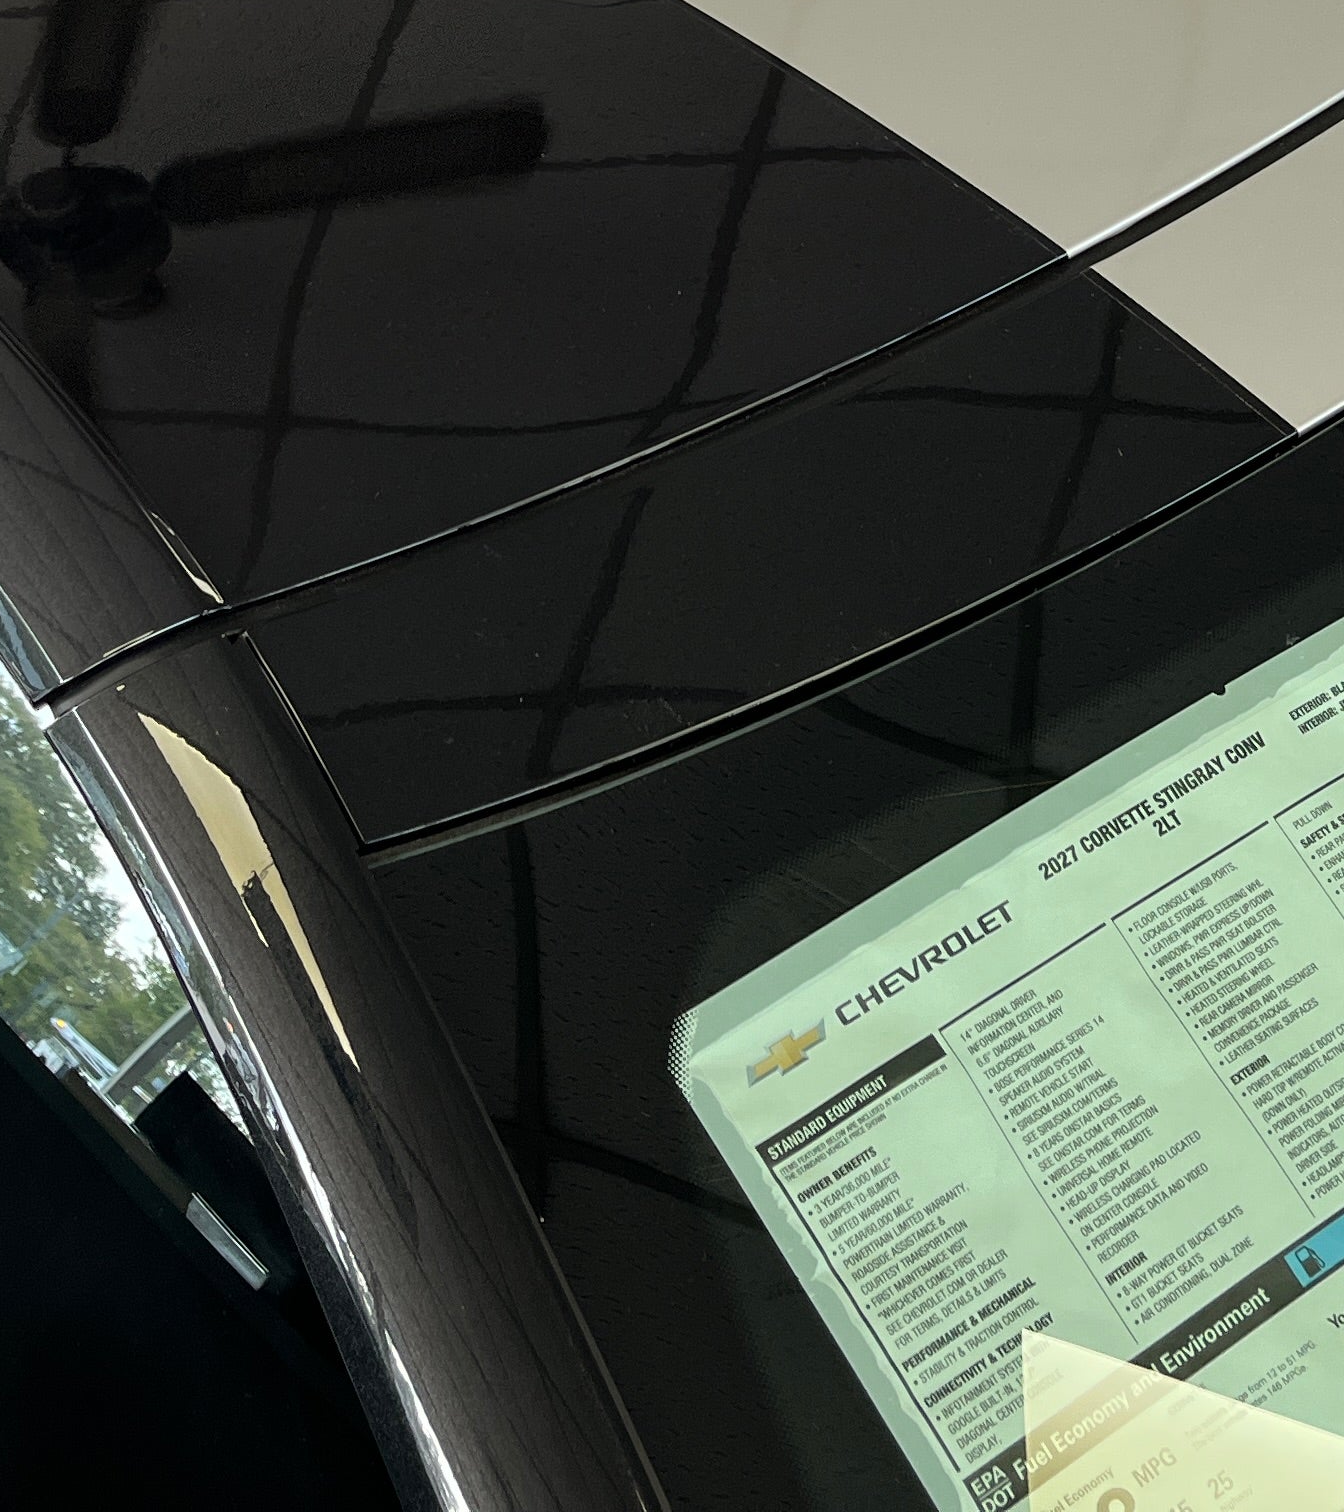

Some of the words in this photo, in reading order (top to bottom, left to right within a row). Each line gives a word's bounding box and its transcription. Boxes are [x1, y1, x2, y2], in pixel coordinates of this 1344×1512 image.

[1288, 693, 1332, 721] EXTERIOR:
[1297, 707, 1339, 735] INTERIOR:
[1038, 844, 1078, 880] 2027
[1080, 799, 1155, 853] CORVETTE
[1152, 755, 1225, 809] STINGRAY
[1224, 731, 1266, 764] CONV
[1152, 809, 1181, 837] 2LT
[1300, 824, 1331, 849] SAFETY
[1330, 820, 1340, 830] &
[835, 900, 1012, 1026] CHEVROLET
[1224, 1038, 1257, 1064] LEATHER
[1254, 1020, 1284, 1044] SEATING
[1281, 997, 1319, 1026] SURFACES
[1008, 1092, 1041, 1118] REMOTE
[1038, 1073, 1071, 1098] VEHICLE
[1068, 1057, 1094, 1079] START
[1230, 1054, 1271, 1086] EXTERIOR
[767, 1116, 827, 1160] STANDARD
[825, 1075, 887, 1123] EQUIPMENT
[797, 1175, 834, 1203] OWNER
[832, 1146, 877, 1181] BENEFITS
[819, 1171, 900, 1229] BUMPER-TO-BUMPER
[827, 1215, 860, 1242] LIMITED
[858, 1188, 901, 1221] WARRANTY
[860, 1263, 901, 1296] COURTESY
[899, 1219, 968, 1269] TRANSPORTATION
[1104, 1252, 1148, 1286] INTERIOR
[901, 1320, 970, 1373] PERFORMANCE
[969, 1315, 979, 1327] &
[977, 1277, 1036, 1321] MECHANICAL
[1014, 1441, 1053, 1480] Fuel
[1053, 1391, 1129, 1452] Economy
[1129, 1366, 1163, 1396] and
[1162, 1288, 1270, 1374] Environment
[971, 1463, 1007, 1496] EPA
[981, 1482, 1017, 1512] DOT
